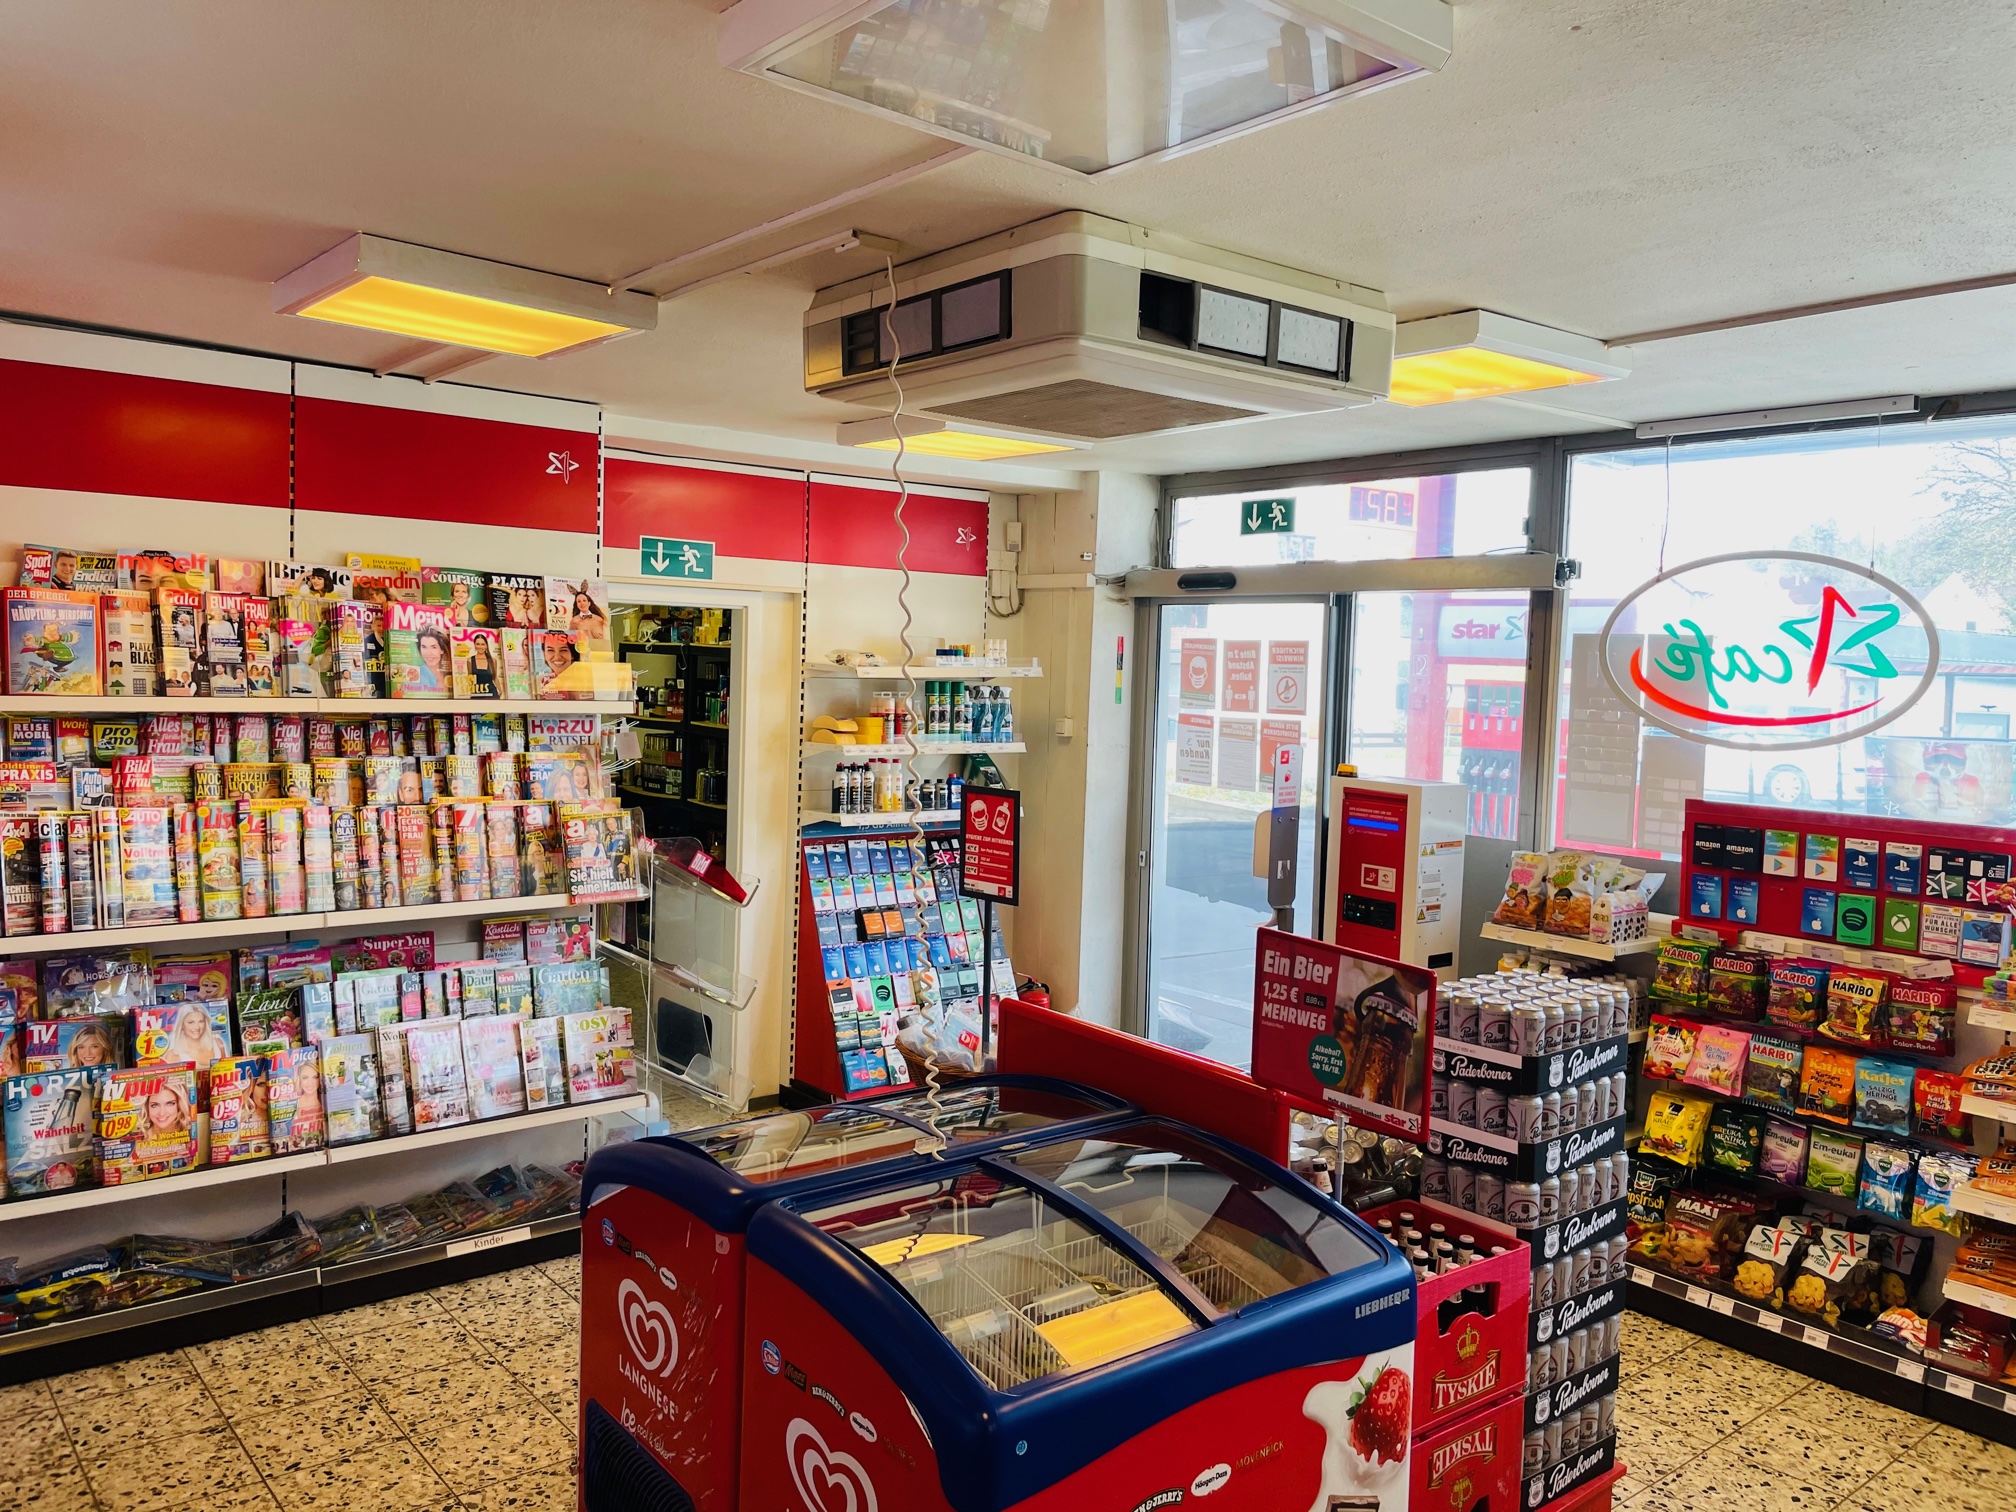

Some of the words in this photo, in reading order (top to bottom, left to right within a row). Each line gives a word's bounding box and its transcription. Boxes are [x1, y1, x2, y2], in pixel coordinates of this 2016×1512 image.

[25, 554, 51, 570] Sport
[95, 558, 115, 569] 2021
[118, 552, 208, 574] myself
[33, 570, 49, 579] Bild
[74, 571, 114, 582] Endlich
[431, 572, 485, 588] courage
[492, 576, 543, 590] PLAYBO
[7, 590, 27, 598] DER
[30, 592, 70, 601] SPIEGEL
[161, 592, 199, 606] Gala
[245, 603, 268, 620] FRAU
[394, 604, 455, 632] Meins
[452, 629, 501, 644] JOY
[1452, 619, 1500, 639] star
[14, 724, 49, 732] REISE
[149, 717, 181, 732] Alles
[238, 725, 264, 738] Frau
[276, 722, 300, 738] Frau
[309, 721, 334, 734] Frau
[101, 727, 130, 738] pro
[342, 726, 363, 739] Viel
[148, 740, 181, 753] Frau
[309, 740, 335, 750] Heute
[125, 760, 150, 774] Bild
[316, 769, 347, 778] FREIZEIT
[0, 770, 54, 780] PRAXIS
[228, 772, 268, 781] FREIZEIT
[399, 807, 412, 816] 20
[337, 828, 356, 836] BLATT
[567, 820, 584, 837] a
[1696, 840, 1720, 849] amazon
[1726, 845, 1753, 853] amazon
[570, 869, 587, 882] Sie
[591, 867, 614, 880] hielt
[6, 885, 30, 893] ECHTE
[571, 882, 600, 896] seine
[603, 879, 633, 891] Hand!
[485, 923, 520, 936] Köstlich
[1925, 918, 1939, 926] FÜR
[1941, 920, 1959, 928] ALLE
[1925, 925, 1959, 935] WÜNSCHE
[529, 927, 545, 935] tina
[546, 926, 566, 937] April
[364, 938, 404, 951] Super
[406, 935, 430, 946] You
[280, 954, 315, 965] playmobil
[1663, 947, 1701, 962] HARIBO
[115, 964, 138, 975] CLUB
[1263, 949, 1290, 977] Ein
[1294, 956, 1332, 985] Bier
[1713, 957, 1753, 973] HARIBO
[499, 974, 515, 982] tina
[538, 968, 590, 985] Garten
[1773, 970, 1816, 986] HARIBO
[1263, 981, 1287, 1000] 1,25
[1290, 987, 1298, 1003] €
[1832, 980, 1874, 997] HARIBO
[1892, 988, 1941, 1005] HARIBO
[1262, 1002, 1326, 1031] MEHRWEG
[570, 1016, 610, 1035] cosy
[29, 1025, 57, 1043] TV
[1314, 1044, 1341, 1057] Alkohol?
[1752, 1044, 1794, 1061] HARIBO
[1893, 1039, 1936, 1051] Color-Rado
[1311, 1053, 1329, 1064] Sorry.
[1330, 1057, 1343, 1066] Erst
[1567, 1044, 1618, 1083] Paderborner
[1322, 1063, 1341, 1075] 16/18.
[1451, 1055, 1513, 1081] Paderborner
[1809, 1059, 1851, 1076] Katjes
[1859, 1070, 1905, 1086] Katjes
[1866, 1091, 1897, 1101] HERINGE
[1868, 1085, 1896, 1094] SALZIGE
[1384, 1114, 1406, 1128] star
[34, 1123, 86, 1140] Wahrheit
[159, 1129, 190, 1139] Wochen
[1765, 1128, 1800, 1148] Em-eukal
[1564, 1127, 1615, 1168] Paderborner
[1714, 1133, 1747, 1148] MENTHOL
[1447, 1138, 1508, 1166] Paderborner
[1813, 1141, 1856, 1160] Em-eukal
[1676, 1199, 1719, 1219] MAXI
[1564, 1208, 1617, 1253] Paderborner
[474, 1235, 504, 1249] Kinder
[62, 1261, 109, 1278] playmobil
[1354, 1288, 1410, 1320] LIEBHERR
[1557, 1289, 1614, 1337] Paderborner
[620, 1354, 675, 1421] LANGNESE
[1434, 1360, 1497, 1410] TYSKIE
[1554, 1367, 1609, 1417] Paderborner
[1432, 1426, 1494, 1480] TYSKIE
[1195, 1469, 1228, 1491] Häagen-Dazs
[1548, 1447, 1604, 1499] Paderborner
